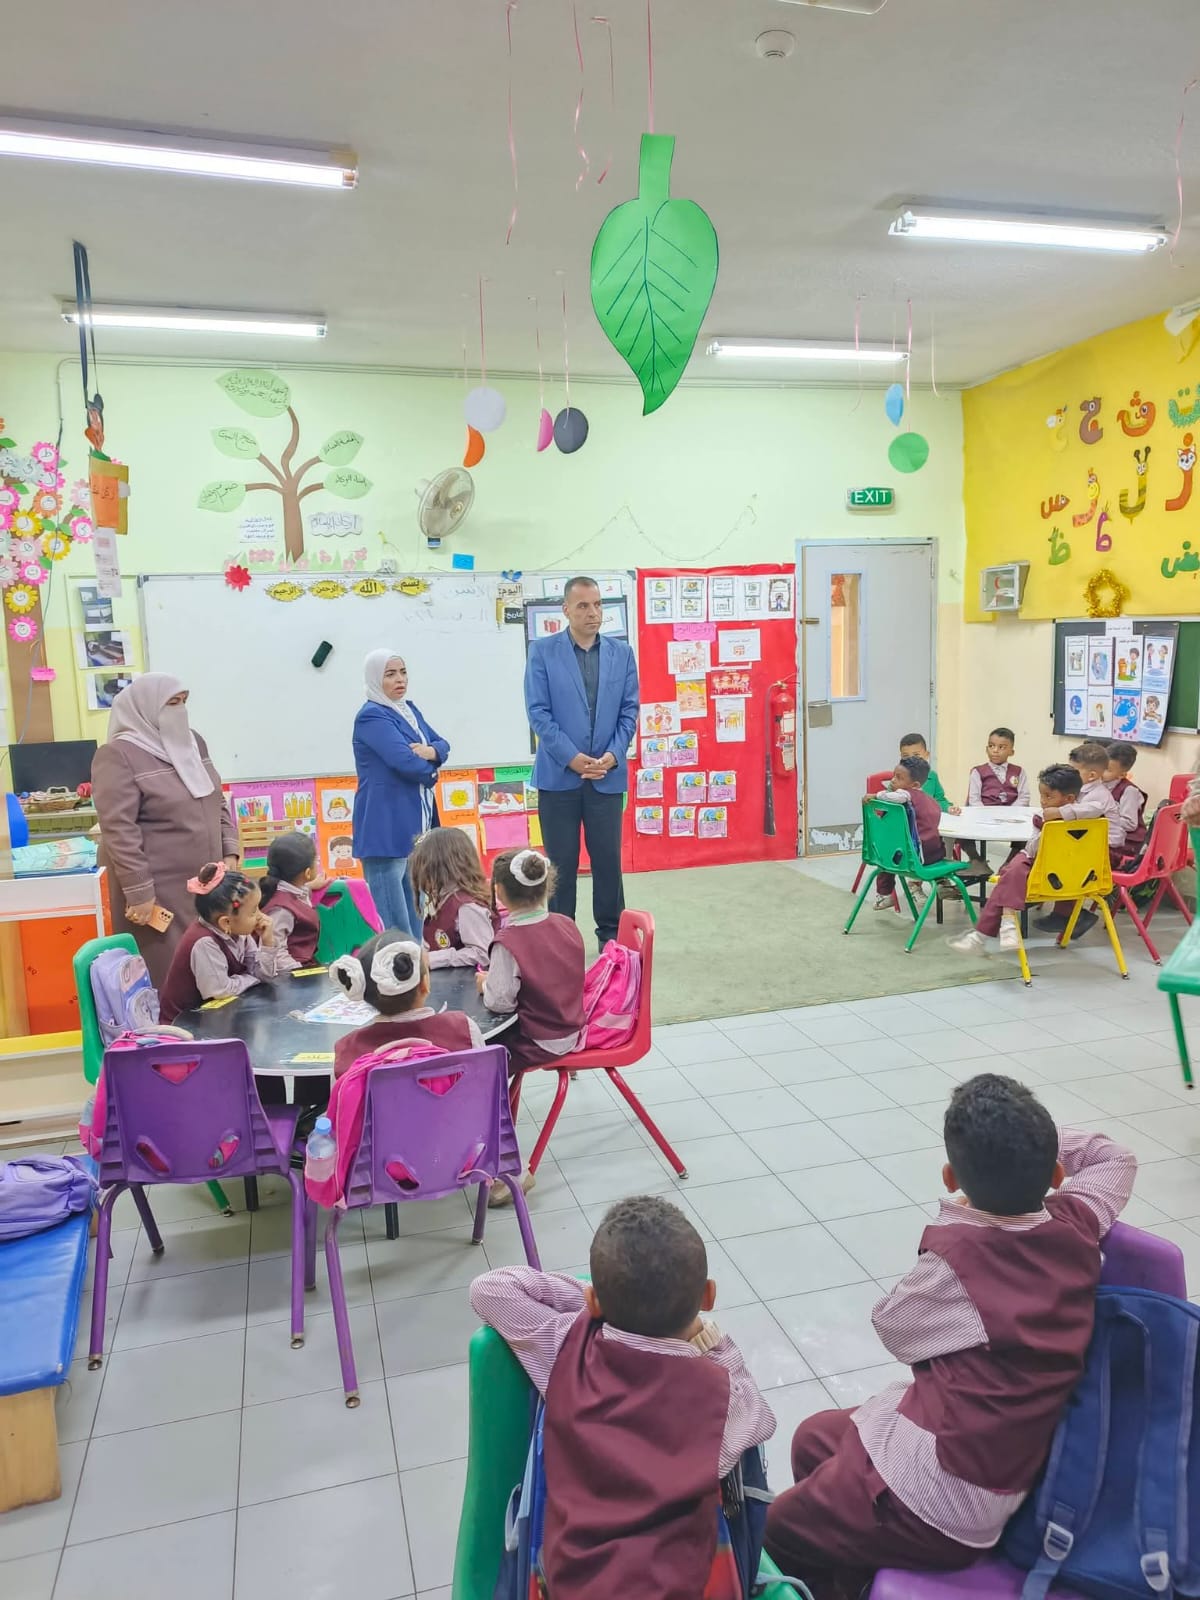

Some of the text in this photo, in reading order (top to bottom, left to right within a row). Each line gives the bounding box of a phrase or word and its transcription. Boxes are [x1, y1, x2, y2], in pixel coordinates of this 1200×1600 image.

[1116, 390, 1157, 438] ث
[1079, 397, 1104, 445] ج
[854, 490, 889, 503] EXIT
[359, 581, 377, 594] الله
[400, 579, 420, 591] بسم
